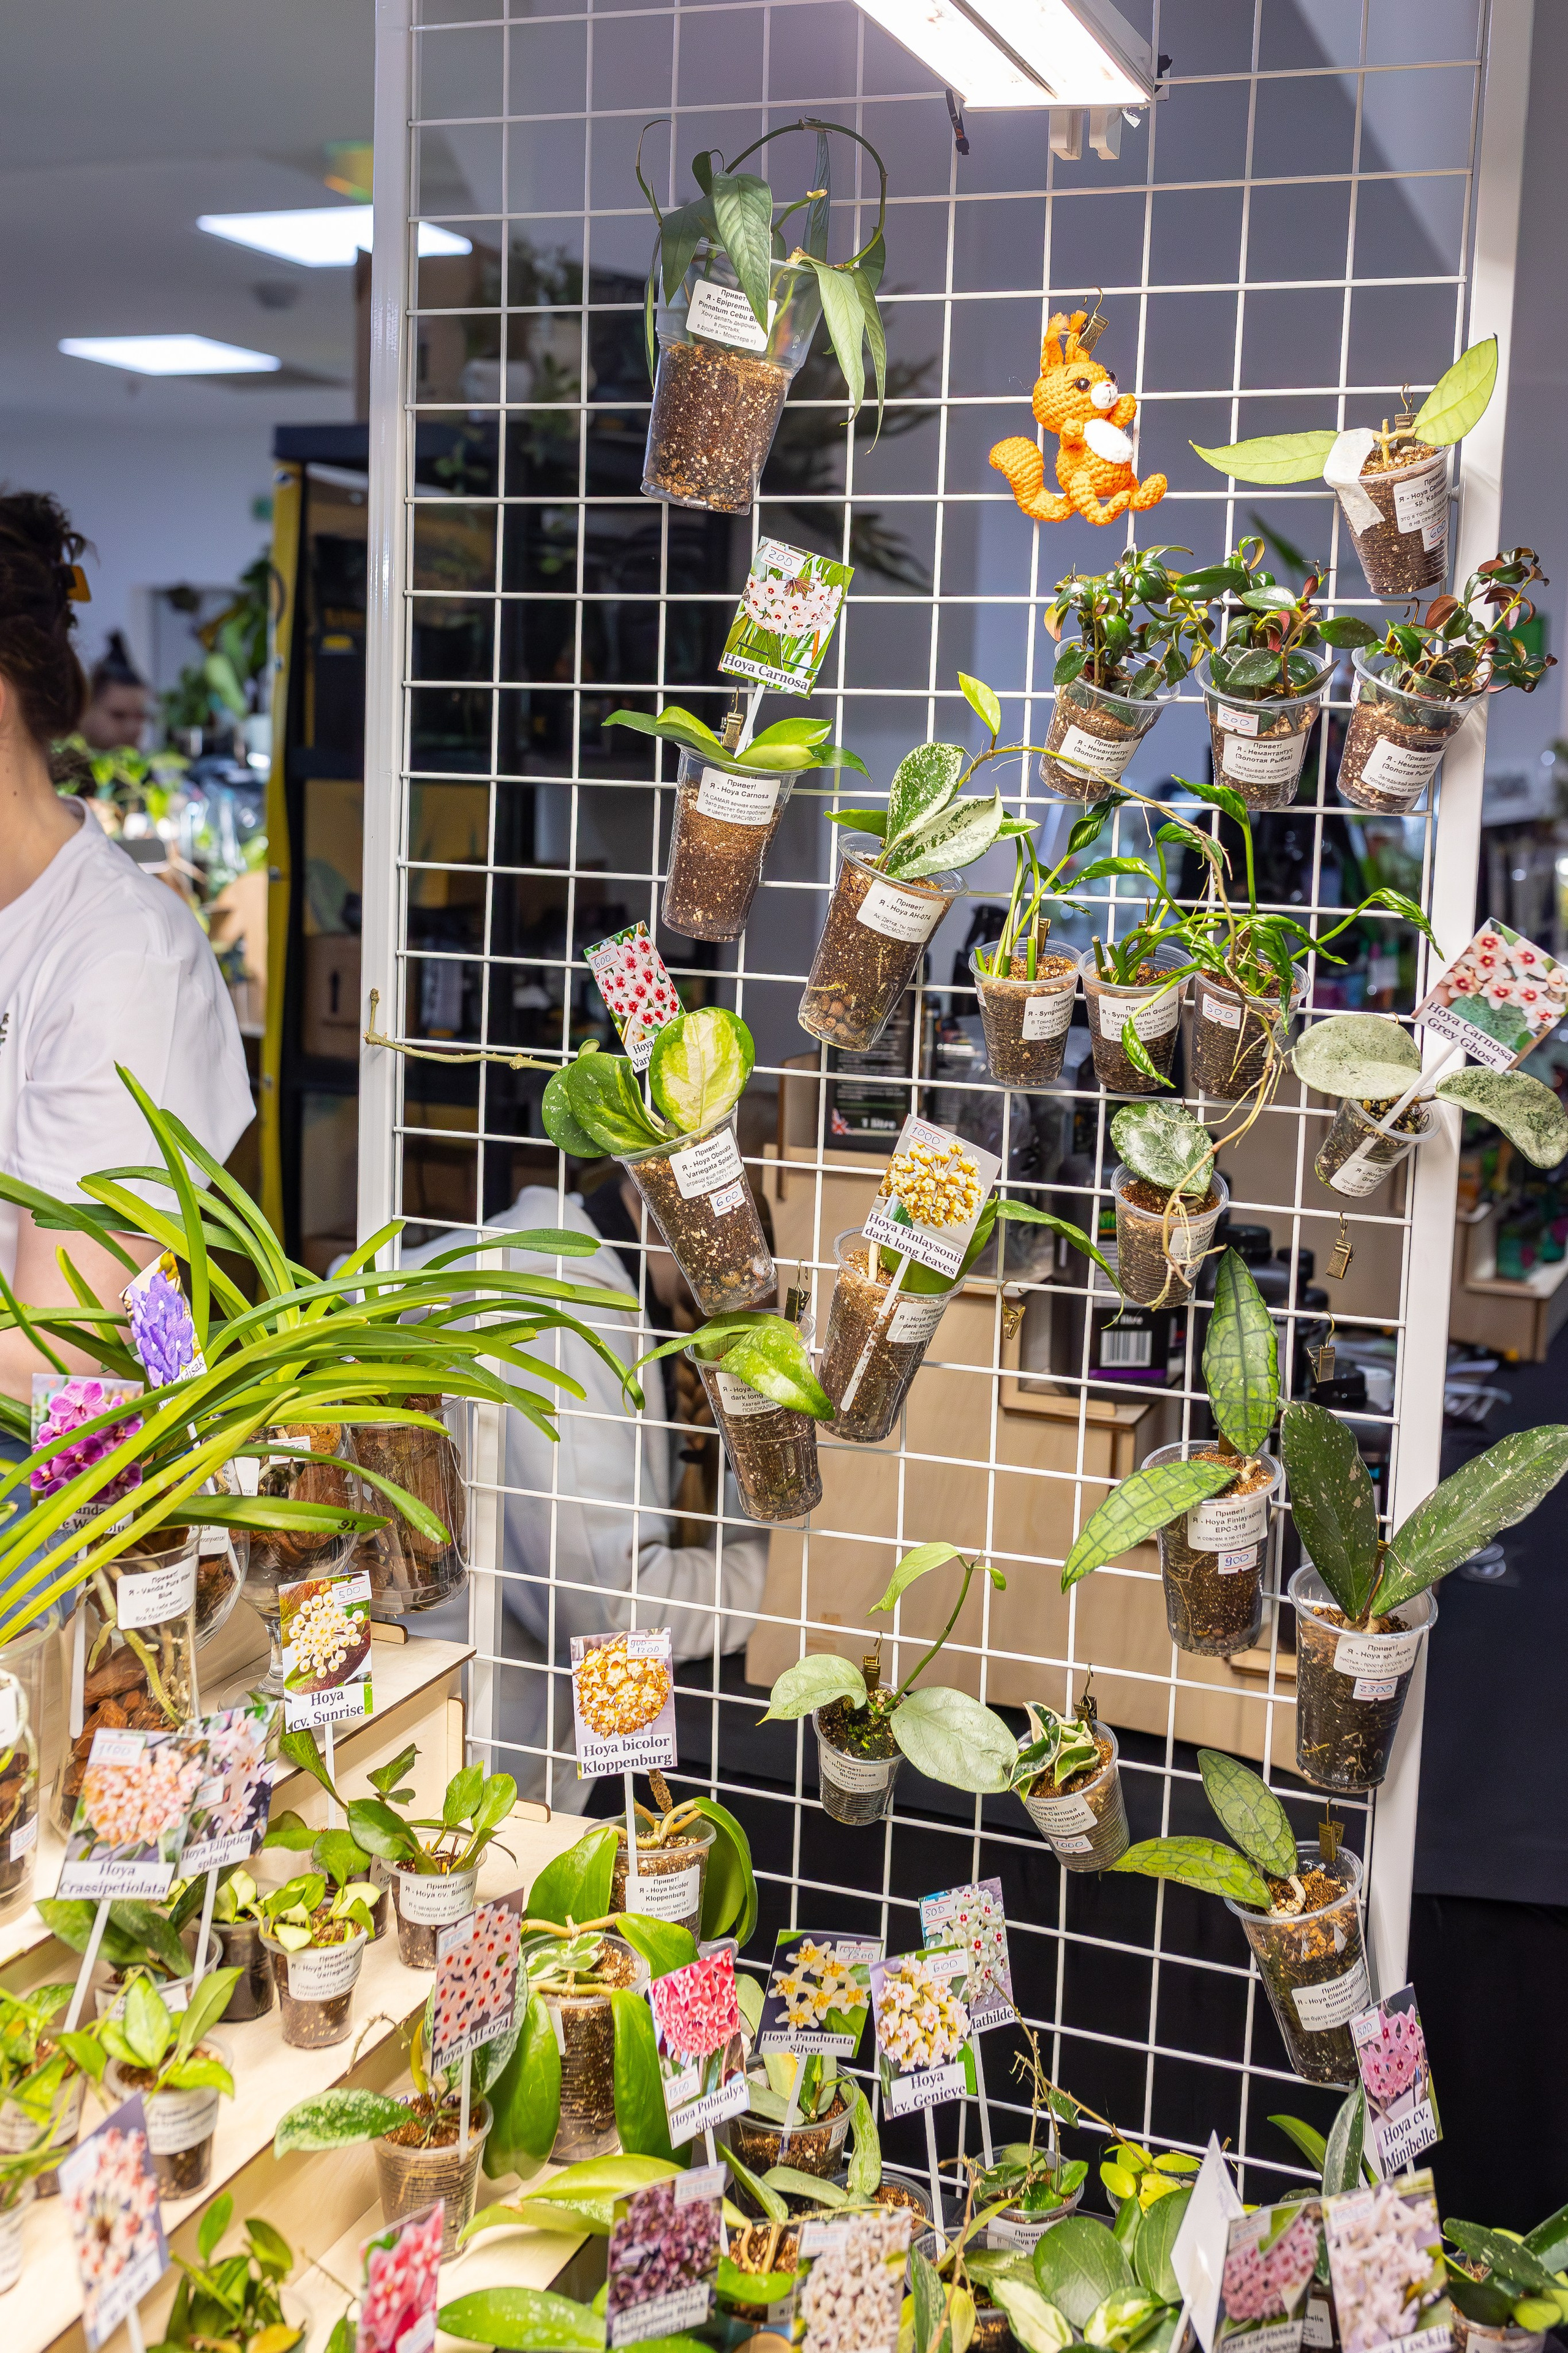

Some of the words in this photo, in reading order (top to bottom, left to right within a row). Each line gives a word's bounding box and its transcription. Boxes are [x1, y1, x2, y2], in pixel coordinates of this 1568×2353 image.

[698, 300, 728, 314] Pinnatum
[730, 311, 747, 320] Cebu
[701, 310, 714, 319] Хочу
[714, 314, 733, 324] делать
[734, 320, 756, 330] дырочки
[723, 331, 749, 342] Монстера
[1411, 490, 1428, 499] Hoya
[769, 550, 792, 566] 200
[723, 654, 755, 673] Hoya
[758, 665, 808, 690] Carnosa
[1223, 714, 1249, 726] 500
[1088, 746, 1129, 755] Немантантус
[1094, 739, 1120, 749] Привет!
[1074, 746, 1104, 761] (Золотая
[1235, 753, 1267, 763] (Золотая
[1270, 755, 1292, 763] Рыбка)
[1248, 747, 1293, 756] Немантантус
[1382, 763, 1414, 776] (Золотая
[727, 779, 756, 790] Привет!
[722, 787, 739, 797] Hoya
[711, 795, 729, 804] САМАЯ
[731, 813, 756, 821] КРАСИВО
[896, 898, 924, 911] Привет!
[891, 905, 907, 916] Hoya
[909, 912, 931, 921] AH-074
[595, 955, 611, 968] 600
[1153, 1002, 1177, 1014] Godzilla
[1207, 1003, 1232, 1018] 500
[1427, 1002, 1460, 1026] Hoya
[1463, 1023, 1514, 1062] Carnosa
[633, 1040, 654, 1054] Hoya
[1427, 1018, 1458, 1044] Grey
[1460, 1037, 1498, 1067] Ghost
[912, 1127, 940, 1144] 1000
[695, 1141, 720, 1157] Привет!
[693, 1156, 710, 1168] Hoya
[712, 1145, 731, 1160] Obovata
[686, 1165, 717, 1179] Variegata
[718, 1153, 734, 1166] Splash
[717, 1191, 738, 1207] 600
[869, 1215, 898, 1233] Hoya
[902, 1227, 963, 1264] Finlaysonii
[865, 1227, 892, 1245] dark
[894, 1240, 917, 1258] long
[920, 1252, 956, 1276] leaves
[1216, 1508, 1245, 1517] Привет!
[1216, 1524, 1245, 1533] EPC-318
[1225, 1554, 1249, 1566] 900
[339, 1586, 360, 1598] 500
[311, 1690, 344, 1707] Hoya
[293, 1715, 310, 1729] cv.
[314, 1704, 364, 1726] Sunrise
[584, 1742, 618, 1756] Hoya
[622, 1738, 670, 1750] bicolor
[582, 1754, 672, 1774] Kloppenburg
[832, 1762, 846, 1772] Hoya
[1049, 1807, 1077, 1816] Carnosa
[1054, 1811, 1085, 1822] Variegata
[182, 1849, 206, 1860] Hoya
[209, 1835, 251, 1853] Elliptica
[99, 1861, 135, 1877] Hoya
[198, 1853, 229, 1871] splash
[654, 1876, 679, 1885] Привет!
[669, 1881, 688, 1890] bicolor
[451, 1881, 473, 1895] Sunrise
[646, 1890, 685, 1902] Kloppenburg
[925, 1907, 945, 1917] 500
[933, 1960, 957, 1973] 600
[763, 2033, 791, 2042] Hoya
[795, 2033, 853, 2045] Pandurata
[789, 2044, 823, 2053] Silver
[435, 2049, 461, 2070] Hoya
[911, 2073, 944, 2090] Hoya
[672, 2110, 695, 2129] Hoya
[698, 2083, 744, 2113] Pubicalyx
[894, 2103, 910, 2115] cv.
[913, 2085, 965, 2109] Genieve
[696, 2112, 723, 2134] Silver
[1383, 2118, 1411, 2146] Hoya
[1414, 2107, 1429, 2125] cv.
[1385, 2129, 1436, 2170] Minibelle
